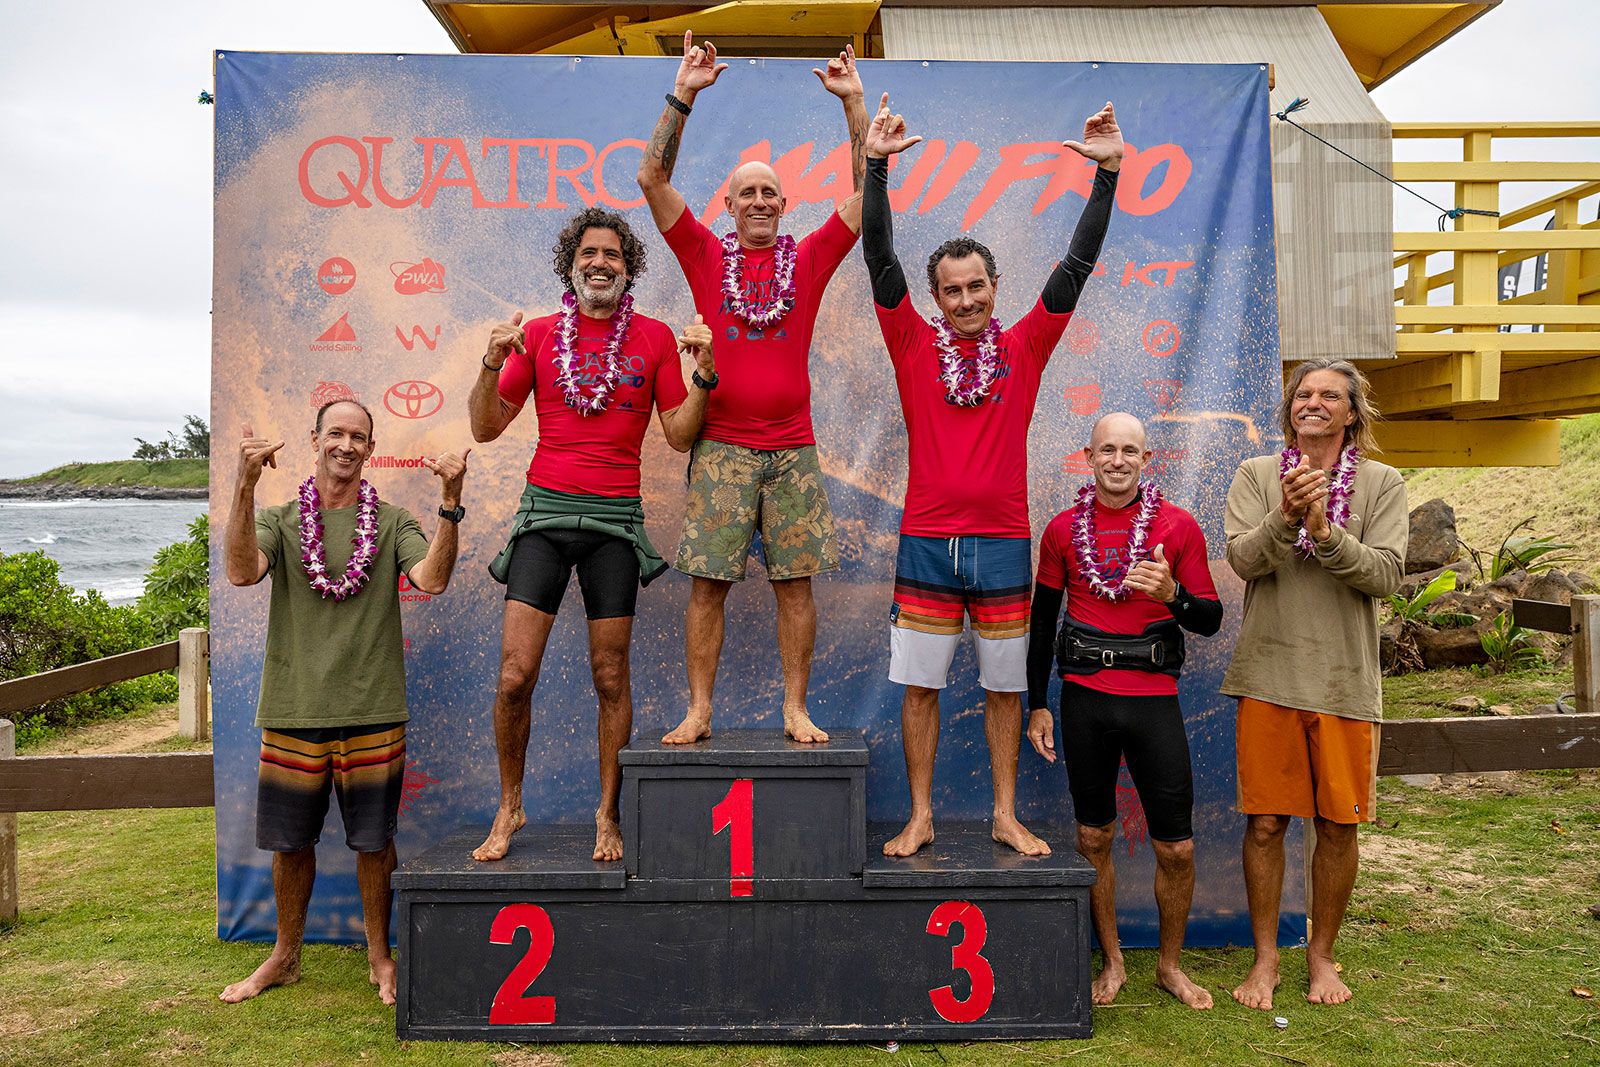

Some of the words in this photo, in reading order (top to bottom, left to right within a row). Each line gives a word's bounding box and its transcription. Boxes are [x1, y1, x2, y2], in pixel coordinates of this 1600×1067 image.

[298, 135, 654, 209] QUATRO
[401, 273, 439, 285] PWA
[1120, 261, 1196, 287] KT
[309, 343, 334, 352] World
[335, 344, 363, 353] Sailing
[712, 778, 754, 898] 1
[489, 903, 556, 1025] 2
[925, 901, 995, 1024] 3
